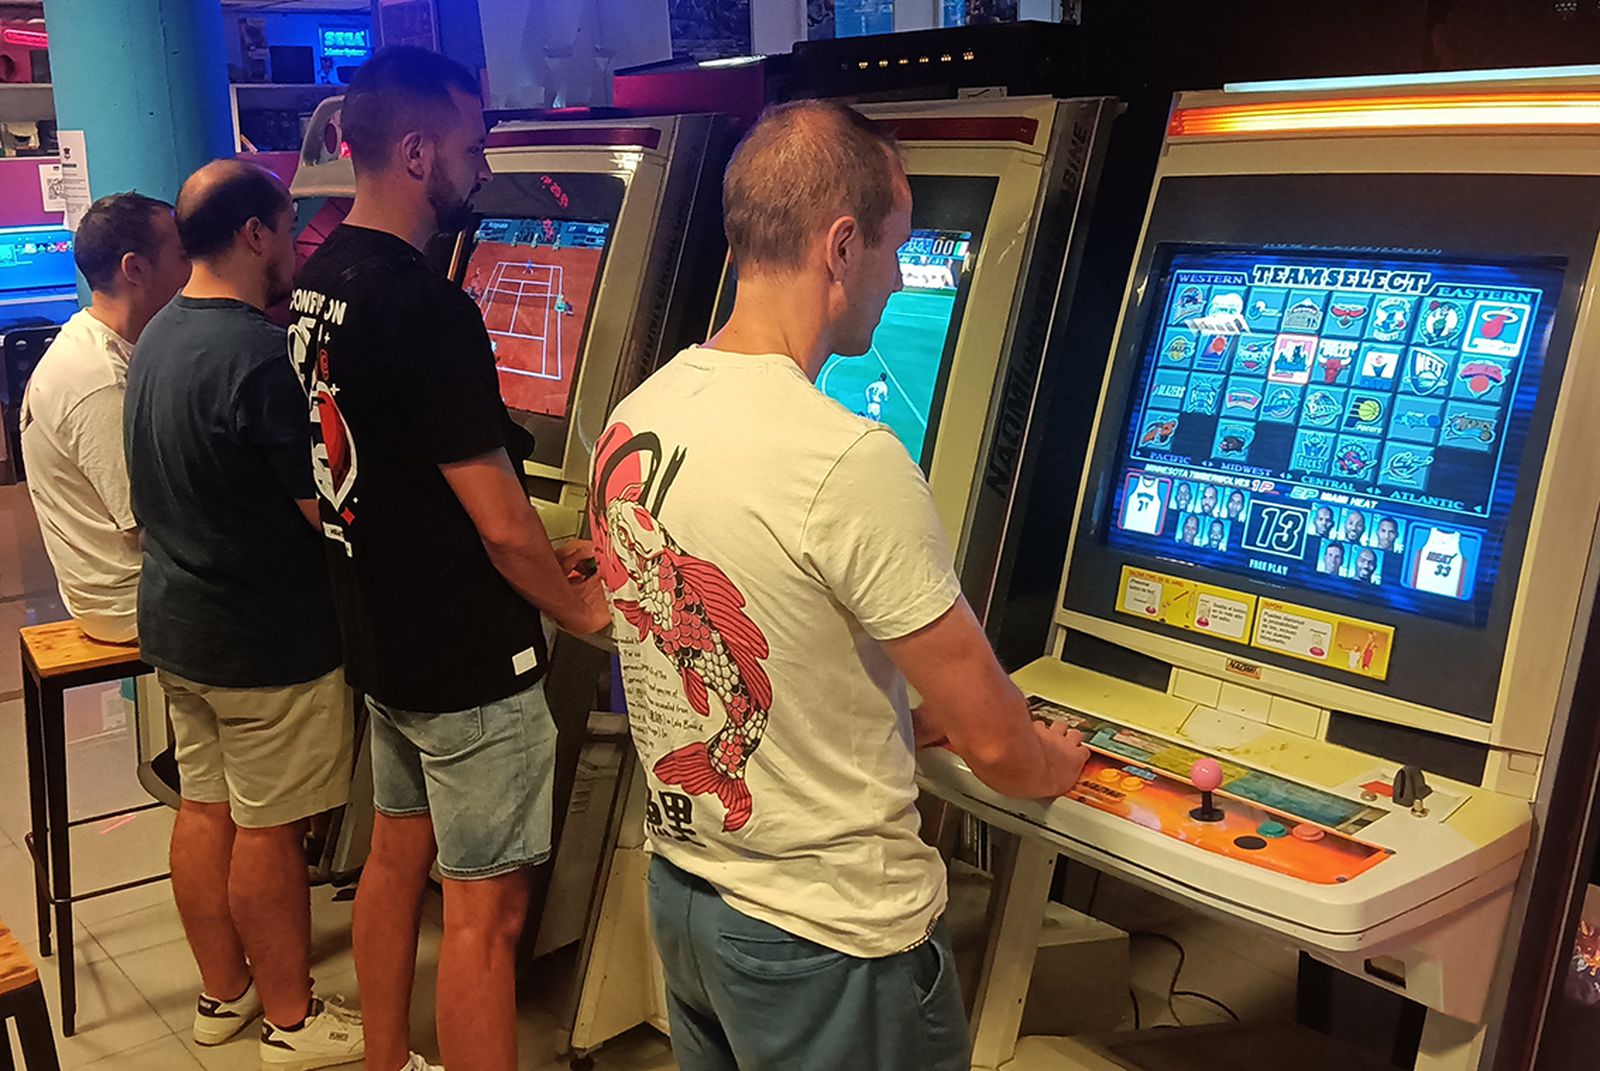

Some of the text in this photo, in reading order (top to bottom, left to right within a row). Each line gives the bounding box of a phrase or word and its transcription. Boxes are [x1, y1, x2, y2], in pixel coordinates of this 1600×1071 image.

[324, 31, 365, 46] SEGA
[1178, 273, 1243, 285] WESTERN
[1254, 265, 1429, 293] TEAM SELECT
[1437, 286, 1532, 304] EASTERN
[1415, 352, 1445, 378] NETS
[1150, 451, 1192, 465] PACIFIC
[1221, 462, 1273, 477] MIDWEST
[1251, 480, 1276, 493] 1P
[1301, 475, 1356, 492] CENTRAL
[1290, 486, 1319, 500] 2P
[1390, 490, 1465, 510] ATLANTIC
[1349, 497, 1378, 509] HEAT
[1256, 507, 1305, 552] 13
[1249, 559, 1289, 576] FREE PLAY
[1434, 564, 1452, 577] 33
